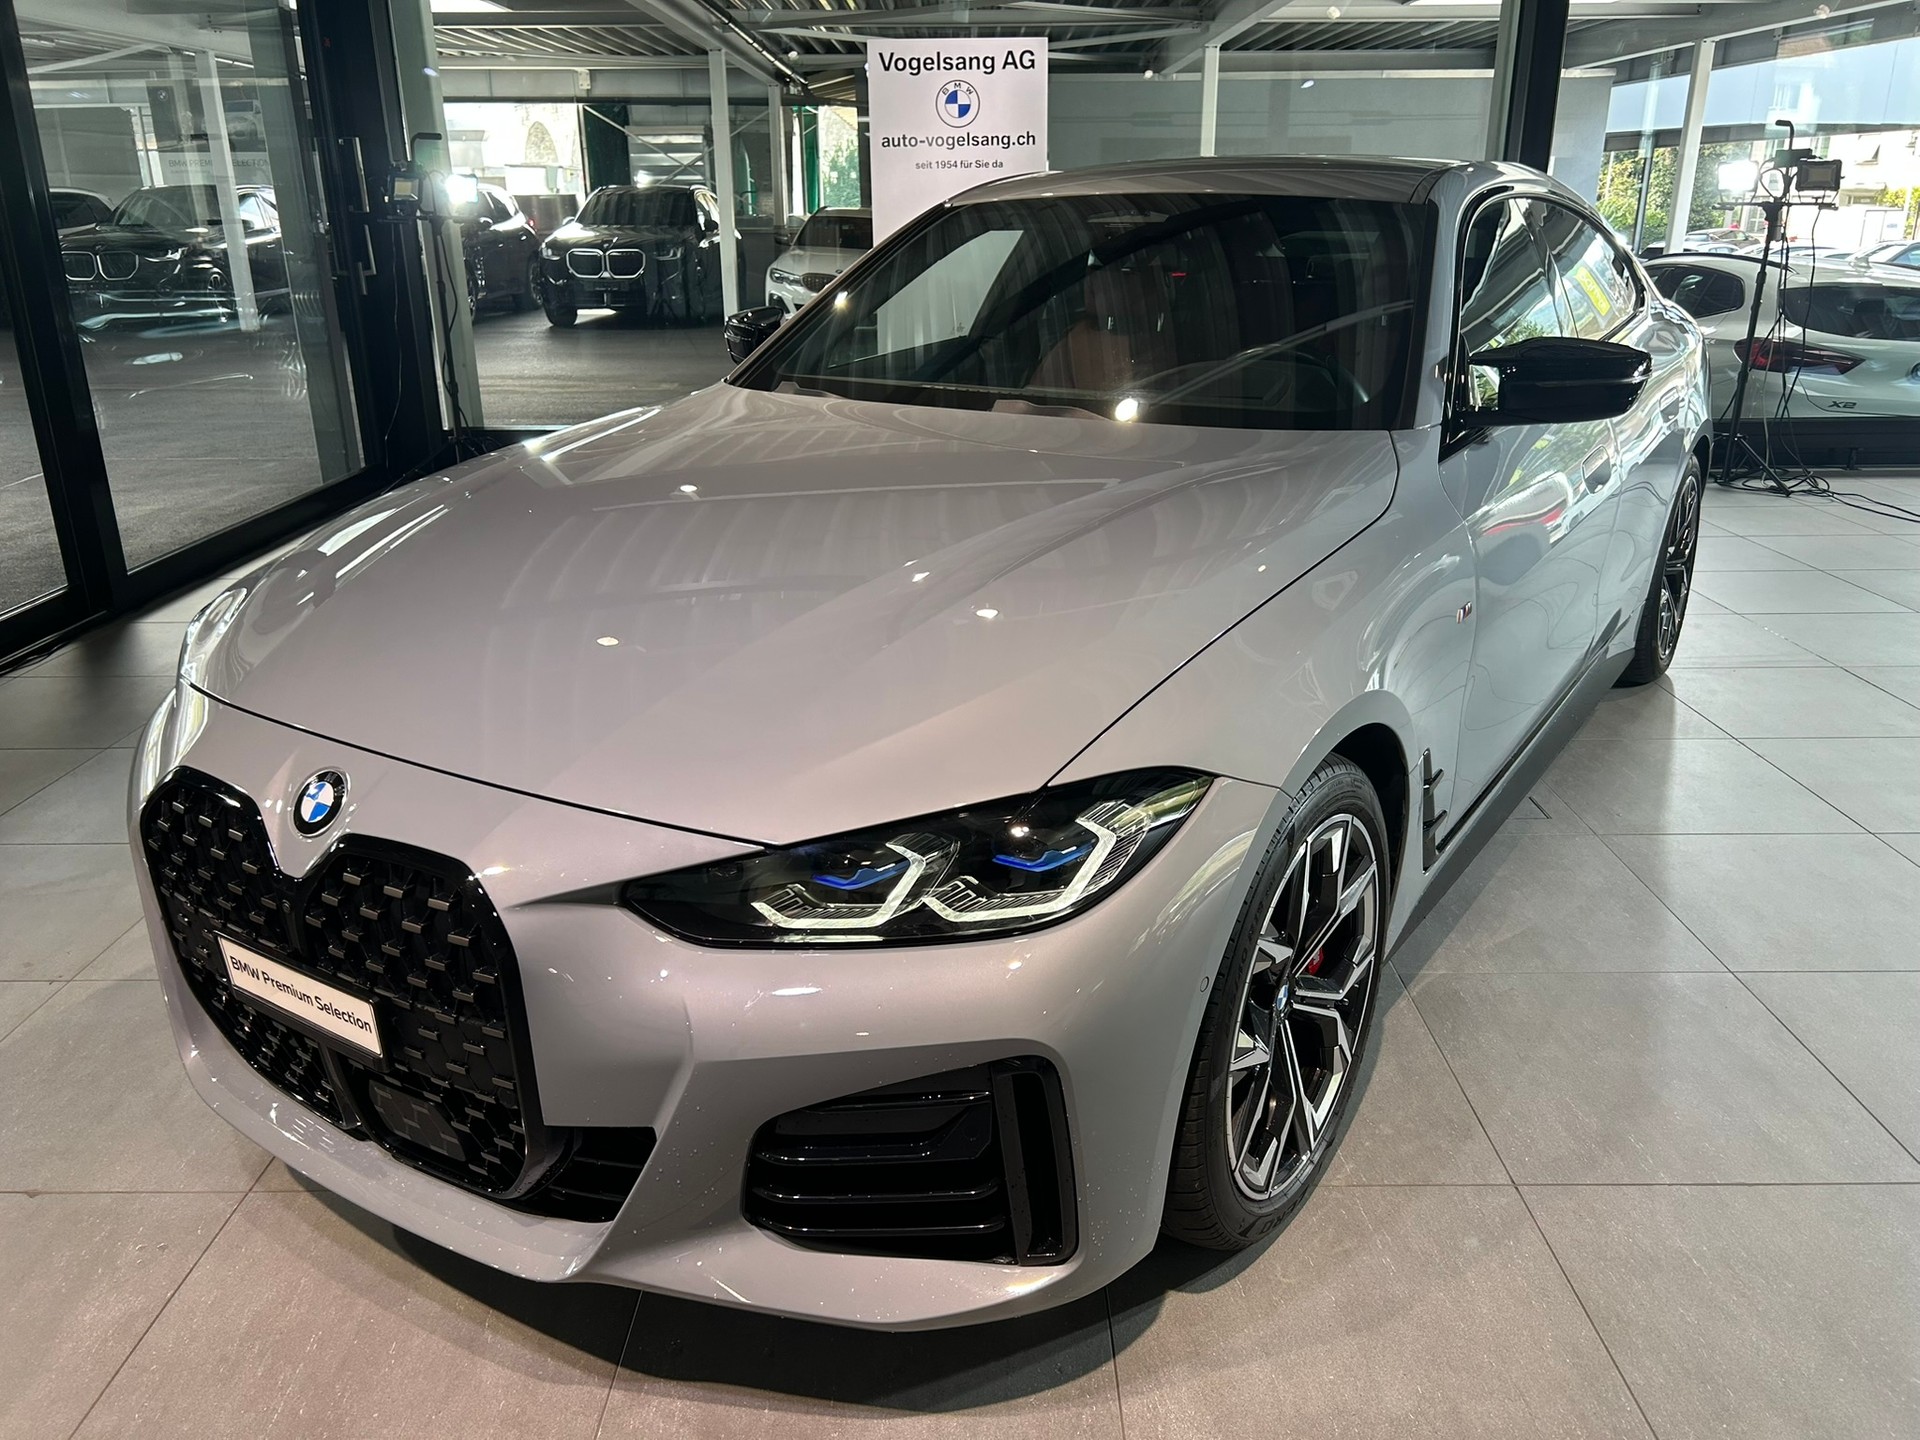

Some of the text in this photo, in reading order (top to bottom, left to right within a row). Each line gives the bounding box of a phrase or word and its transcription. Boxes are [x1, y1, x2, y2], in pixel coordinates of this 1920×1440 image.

[878, 49, 1036, 76] Vogelsang AG
[941, 82, 974, 96] BMW
[881, 131, 1036, 150] auto-vogelsang.ch
[232, 158, 268, 167] ELECTION
[915, 159, 1004, 170] seit 1954 für Sie da
[1827, 400, 1858, 409] X2
[229, 955, 372, 1034] BMW Premium Selection
